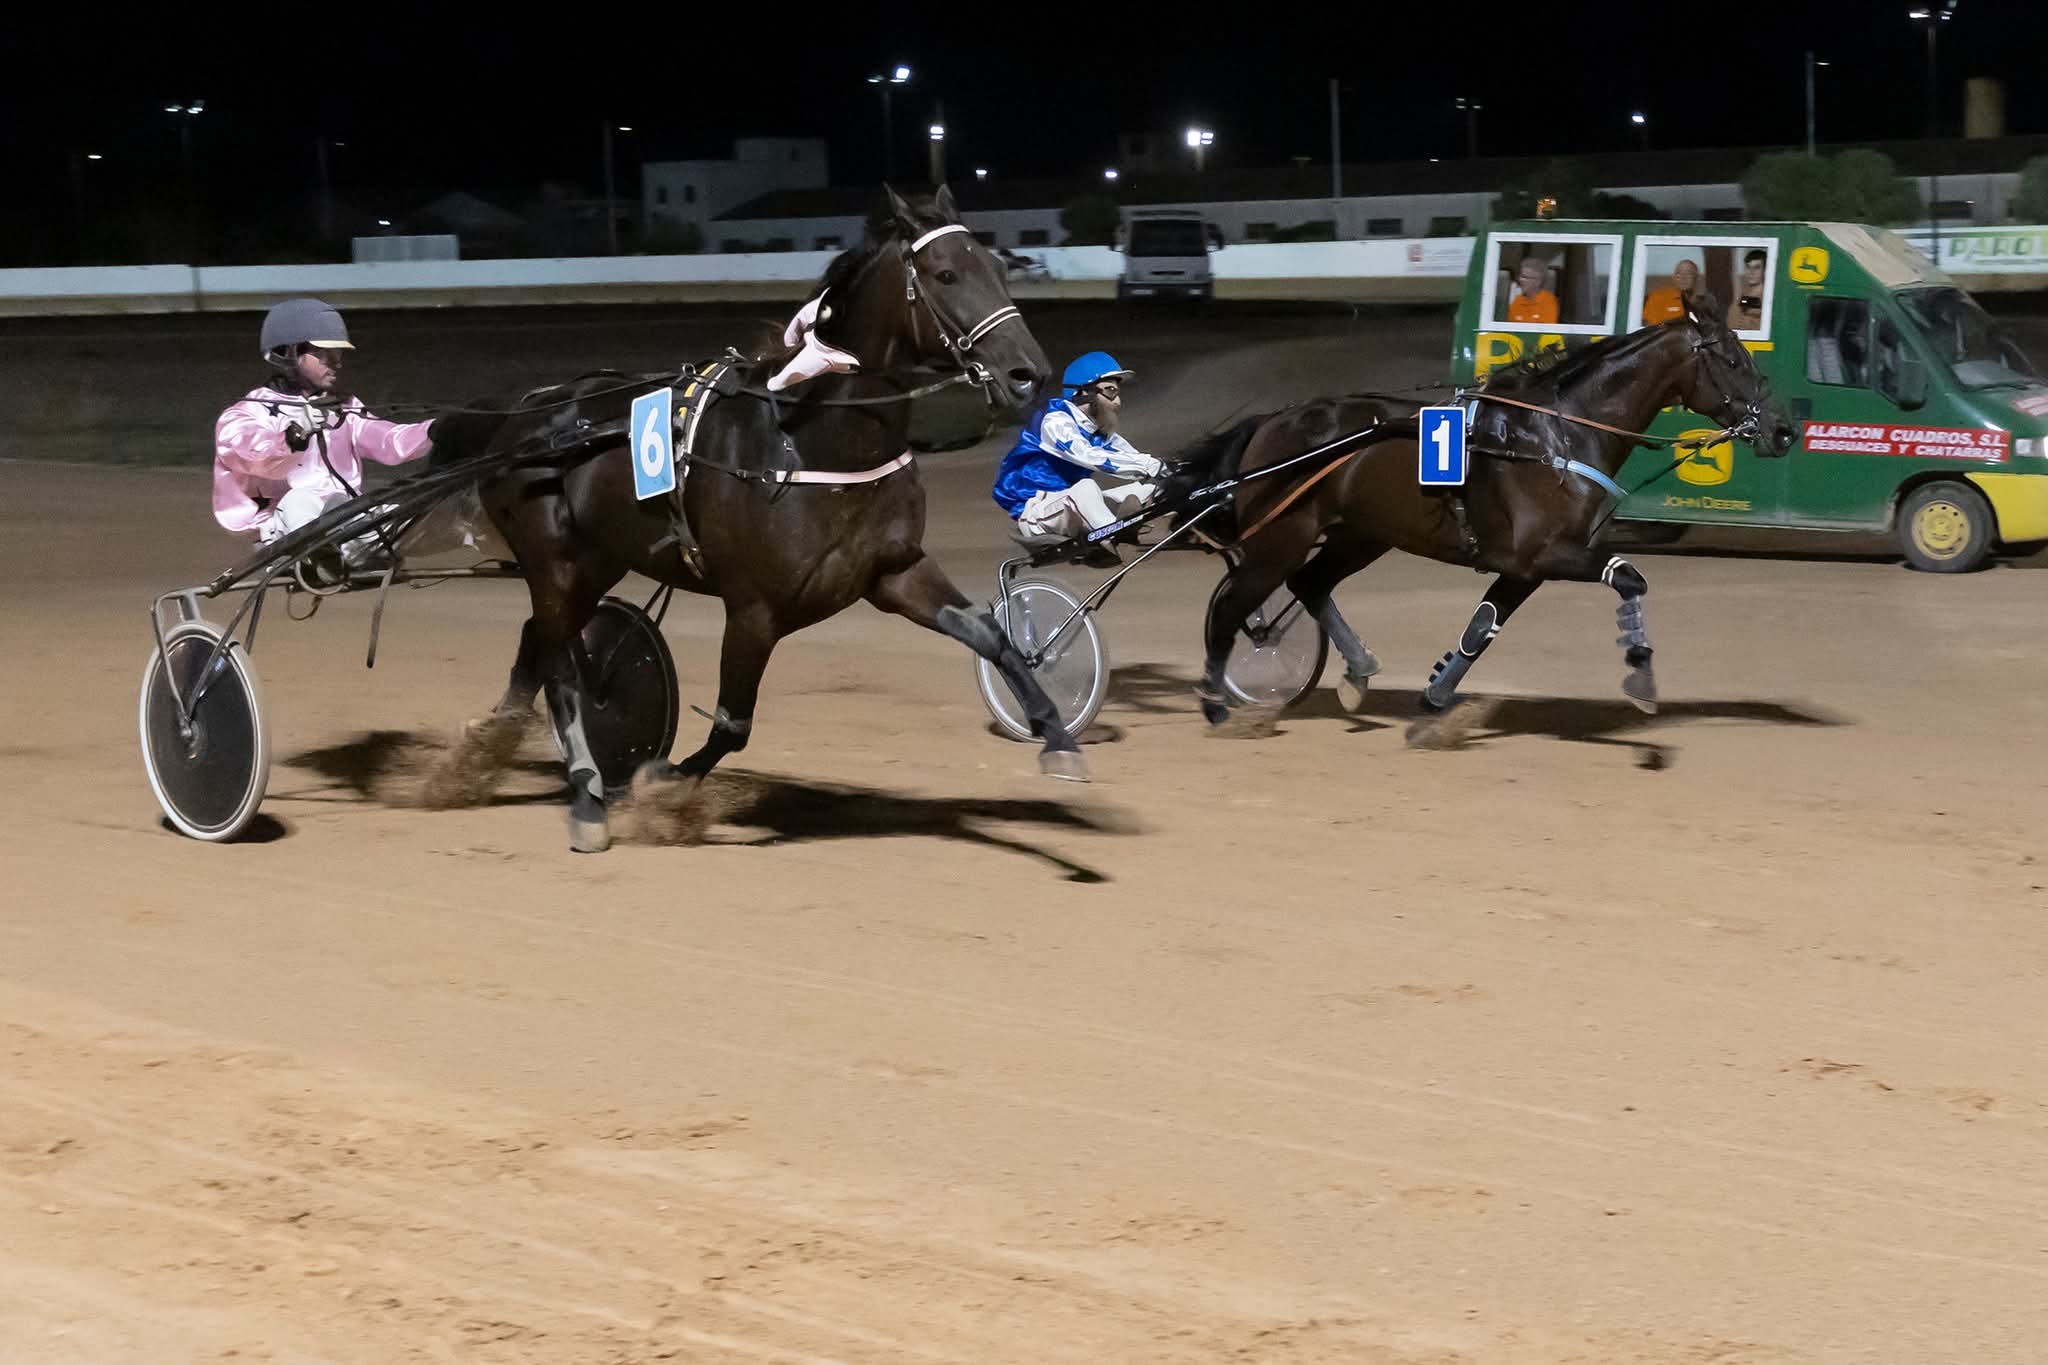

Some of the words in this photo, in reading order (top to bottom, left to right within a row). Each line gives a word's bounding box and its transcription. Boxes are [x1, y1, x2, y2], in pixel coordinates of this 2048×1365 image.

[640, 407, 665, 478] 6
[1431, 419, 1450, 471] 1
[1805, 424, 1885, 440] ALARCON
[1890, 429, 1975, 446] CUADROS,
[1979, 433, 2008, 447] S.L.
[1808, 439, 1891, 454] DESGUACES
[1897, 443, 1910, 455] Y
[1914, 444, 2003, 460] CHATARRAS
